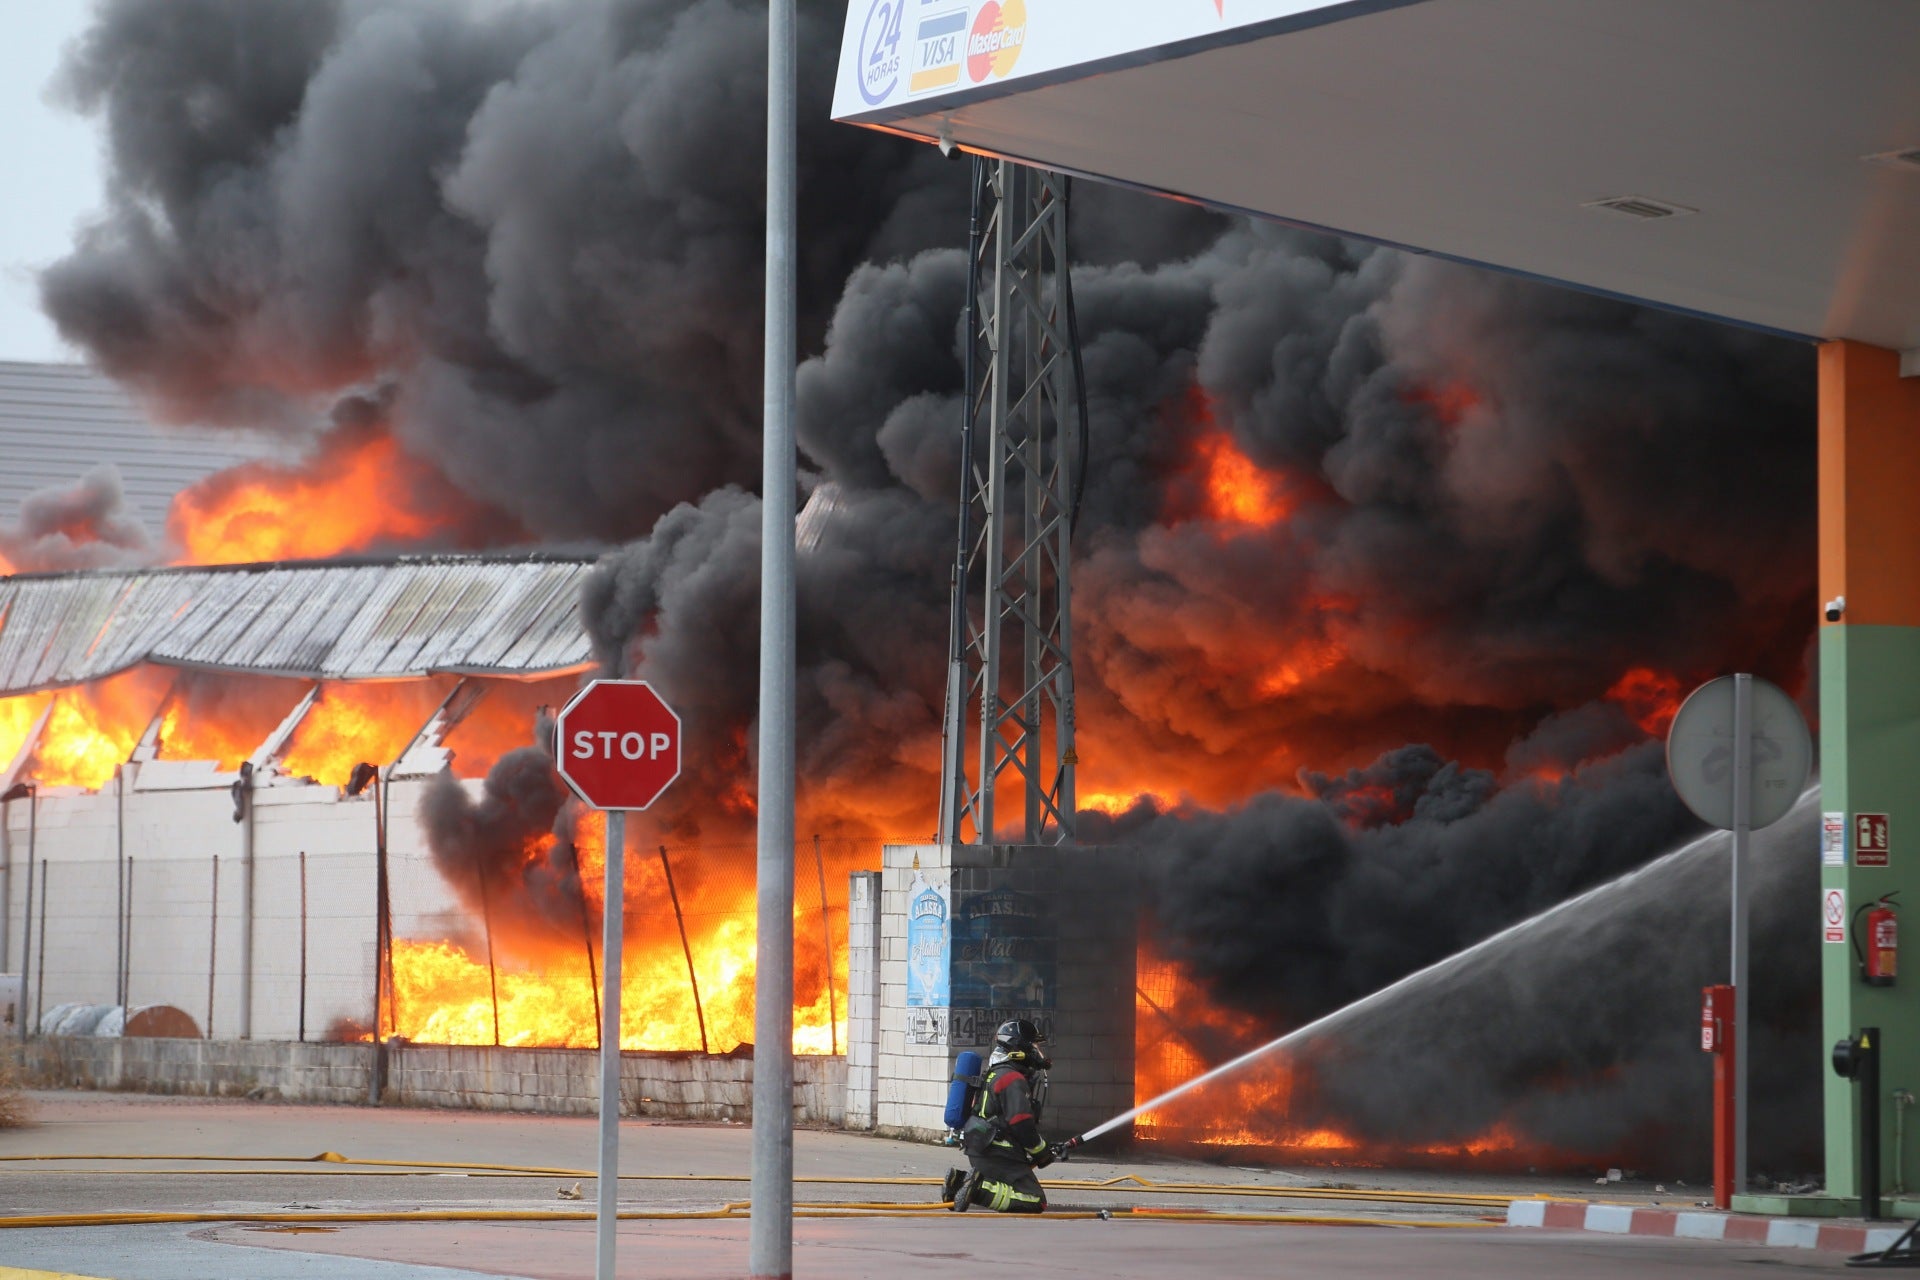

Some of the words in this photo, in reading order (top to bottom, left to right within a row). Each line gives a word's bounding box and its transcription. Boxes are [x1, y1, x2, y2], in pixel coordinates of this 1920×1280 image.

[869, 0, 904, 65] 24
[968, 25, 1025, 56] MasterCard
[922, 36, 955, 67] VISA
[867, 56, 899, 86] HORAS
[572, 730, 670, 760] STOP
[915, 901, 942, 920] ALASKA
[907, 1016, 916, 1036] 14
[938, 1016, 946, 1037] 30
[953, 1016, 975, 1038] 14
